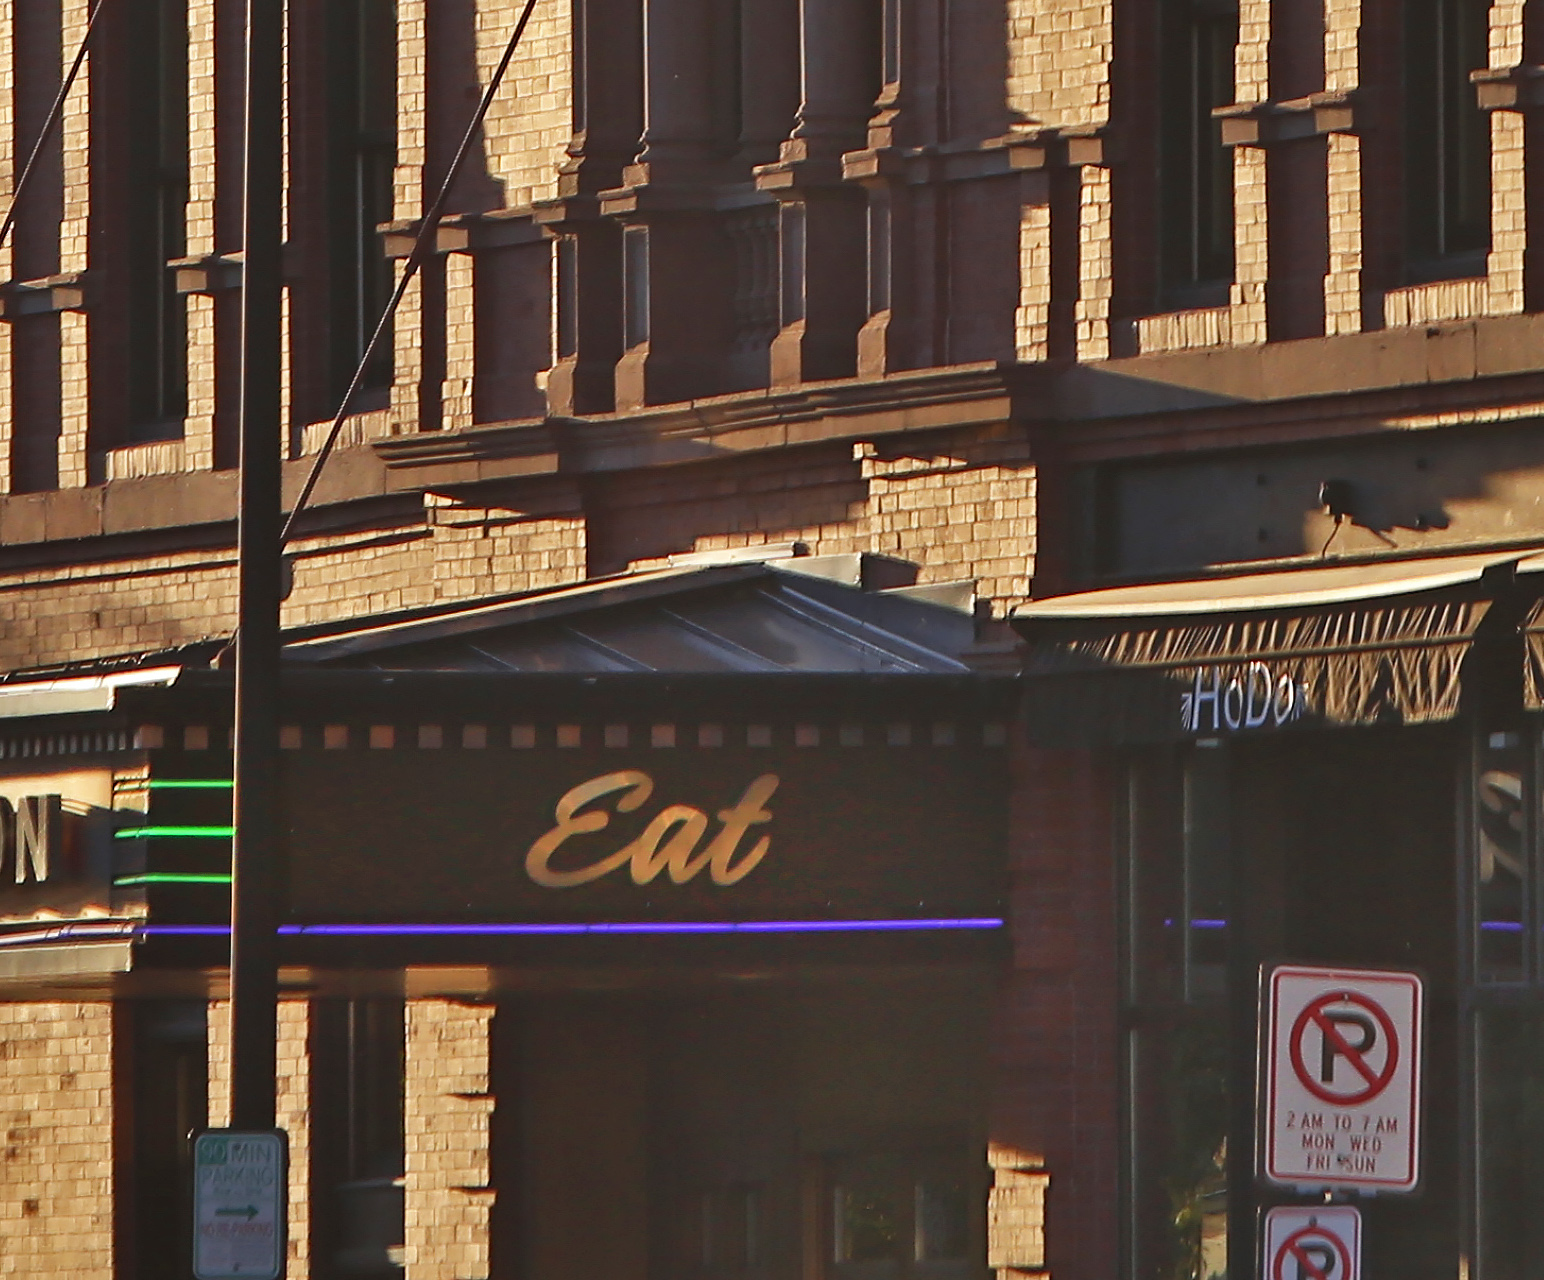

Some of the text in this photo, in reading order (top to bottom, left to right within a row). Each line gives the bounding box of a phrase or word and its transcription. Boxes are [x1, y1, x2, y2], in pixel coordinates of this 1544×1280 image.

[525, 769, 780, 888] Eat
[1286, 1110, 1398, 1134] 2 AM TO 7 AM
[201, 1142, 271, 1162] 90 MIN
[1302, 1133, 1382, 1153] MON WED
[1306, 1153, 1376, 1174] FRI SUN
[202, 1165, 273, 1187] PARKING
